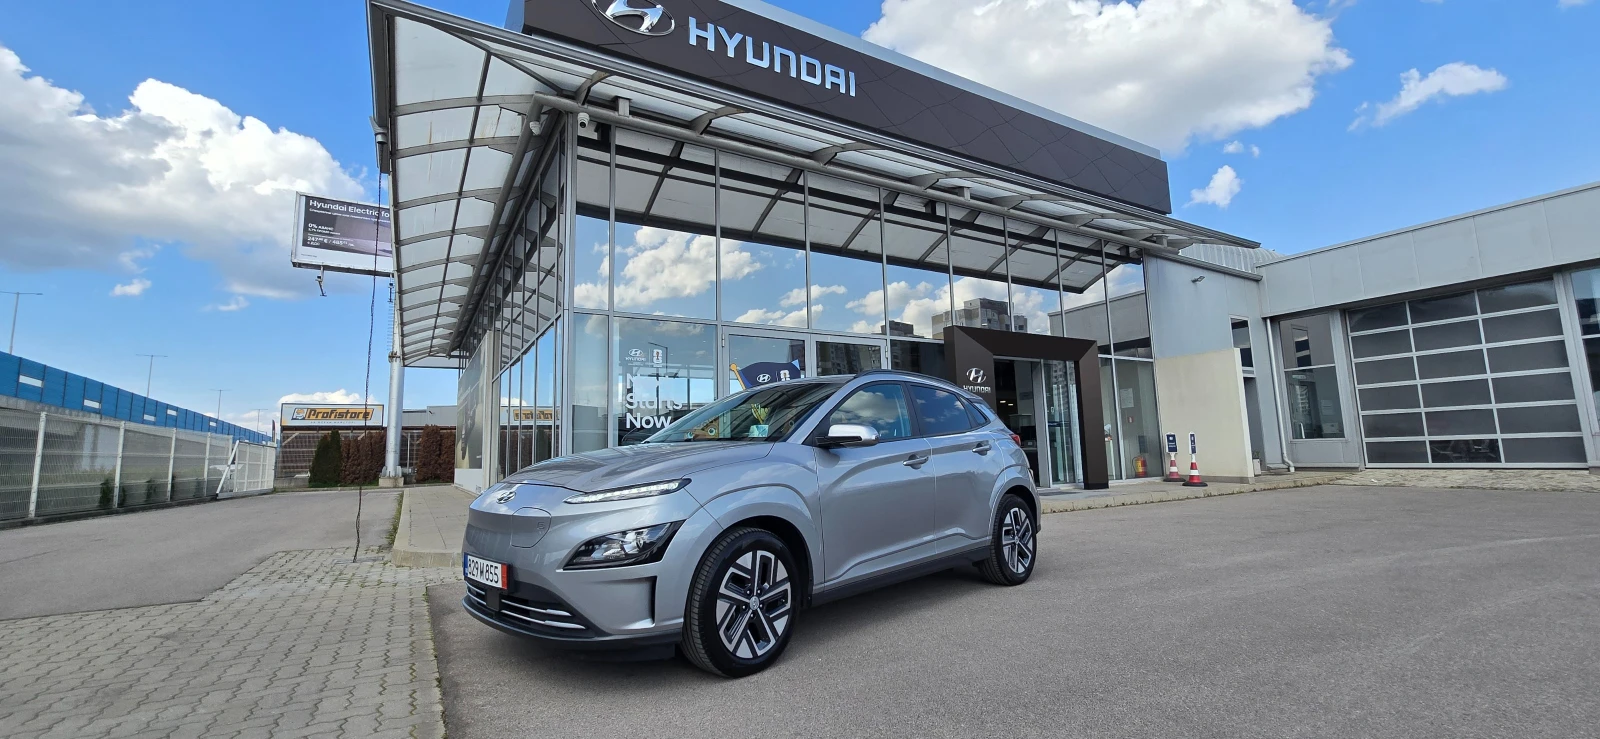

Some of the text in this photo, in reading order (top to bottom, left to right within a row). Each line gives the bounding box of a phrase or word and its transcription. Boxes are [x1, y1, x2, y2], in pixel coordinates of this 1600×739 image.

[688, 16, 856, 97] HYUNDAI
[309, 200, 347, 211] Hyundai
[348, 206, 379, 217] Electric
[963, 385, 991, 393] HYUNDAI
[307, 409, 371, 419] Profistore
[626, 412, 672, 429] Now
